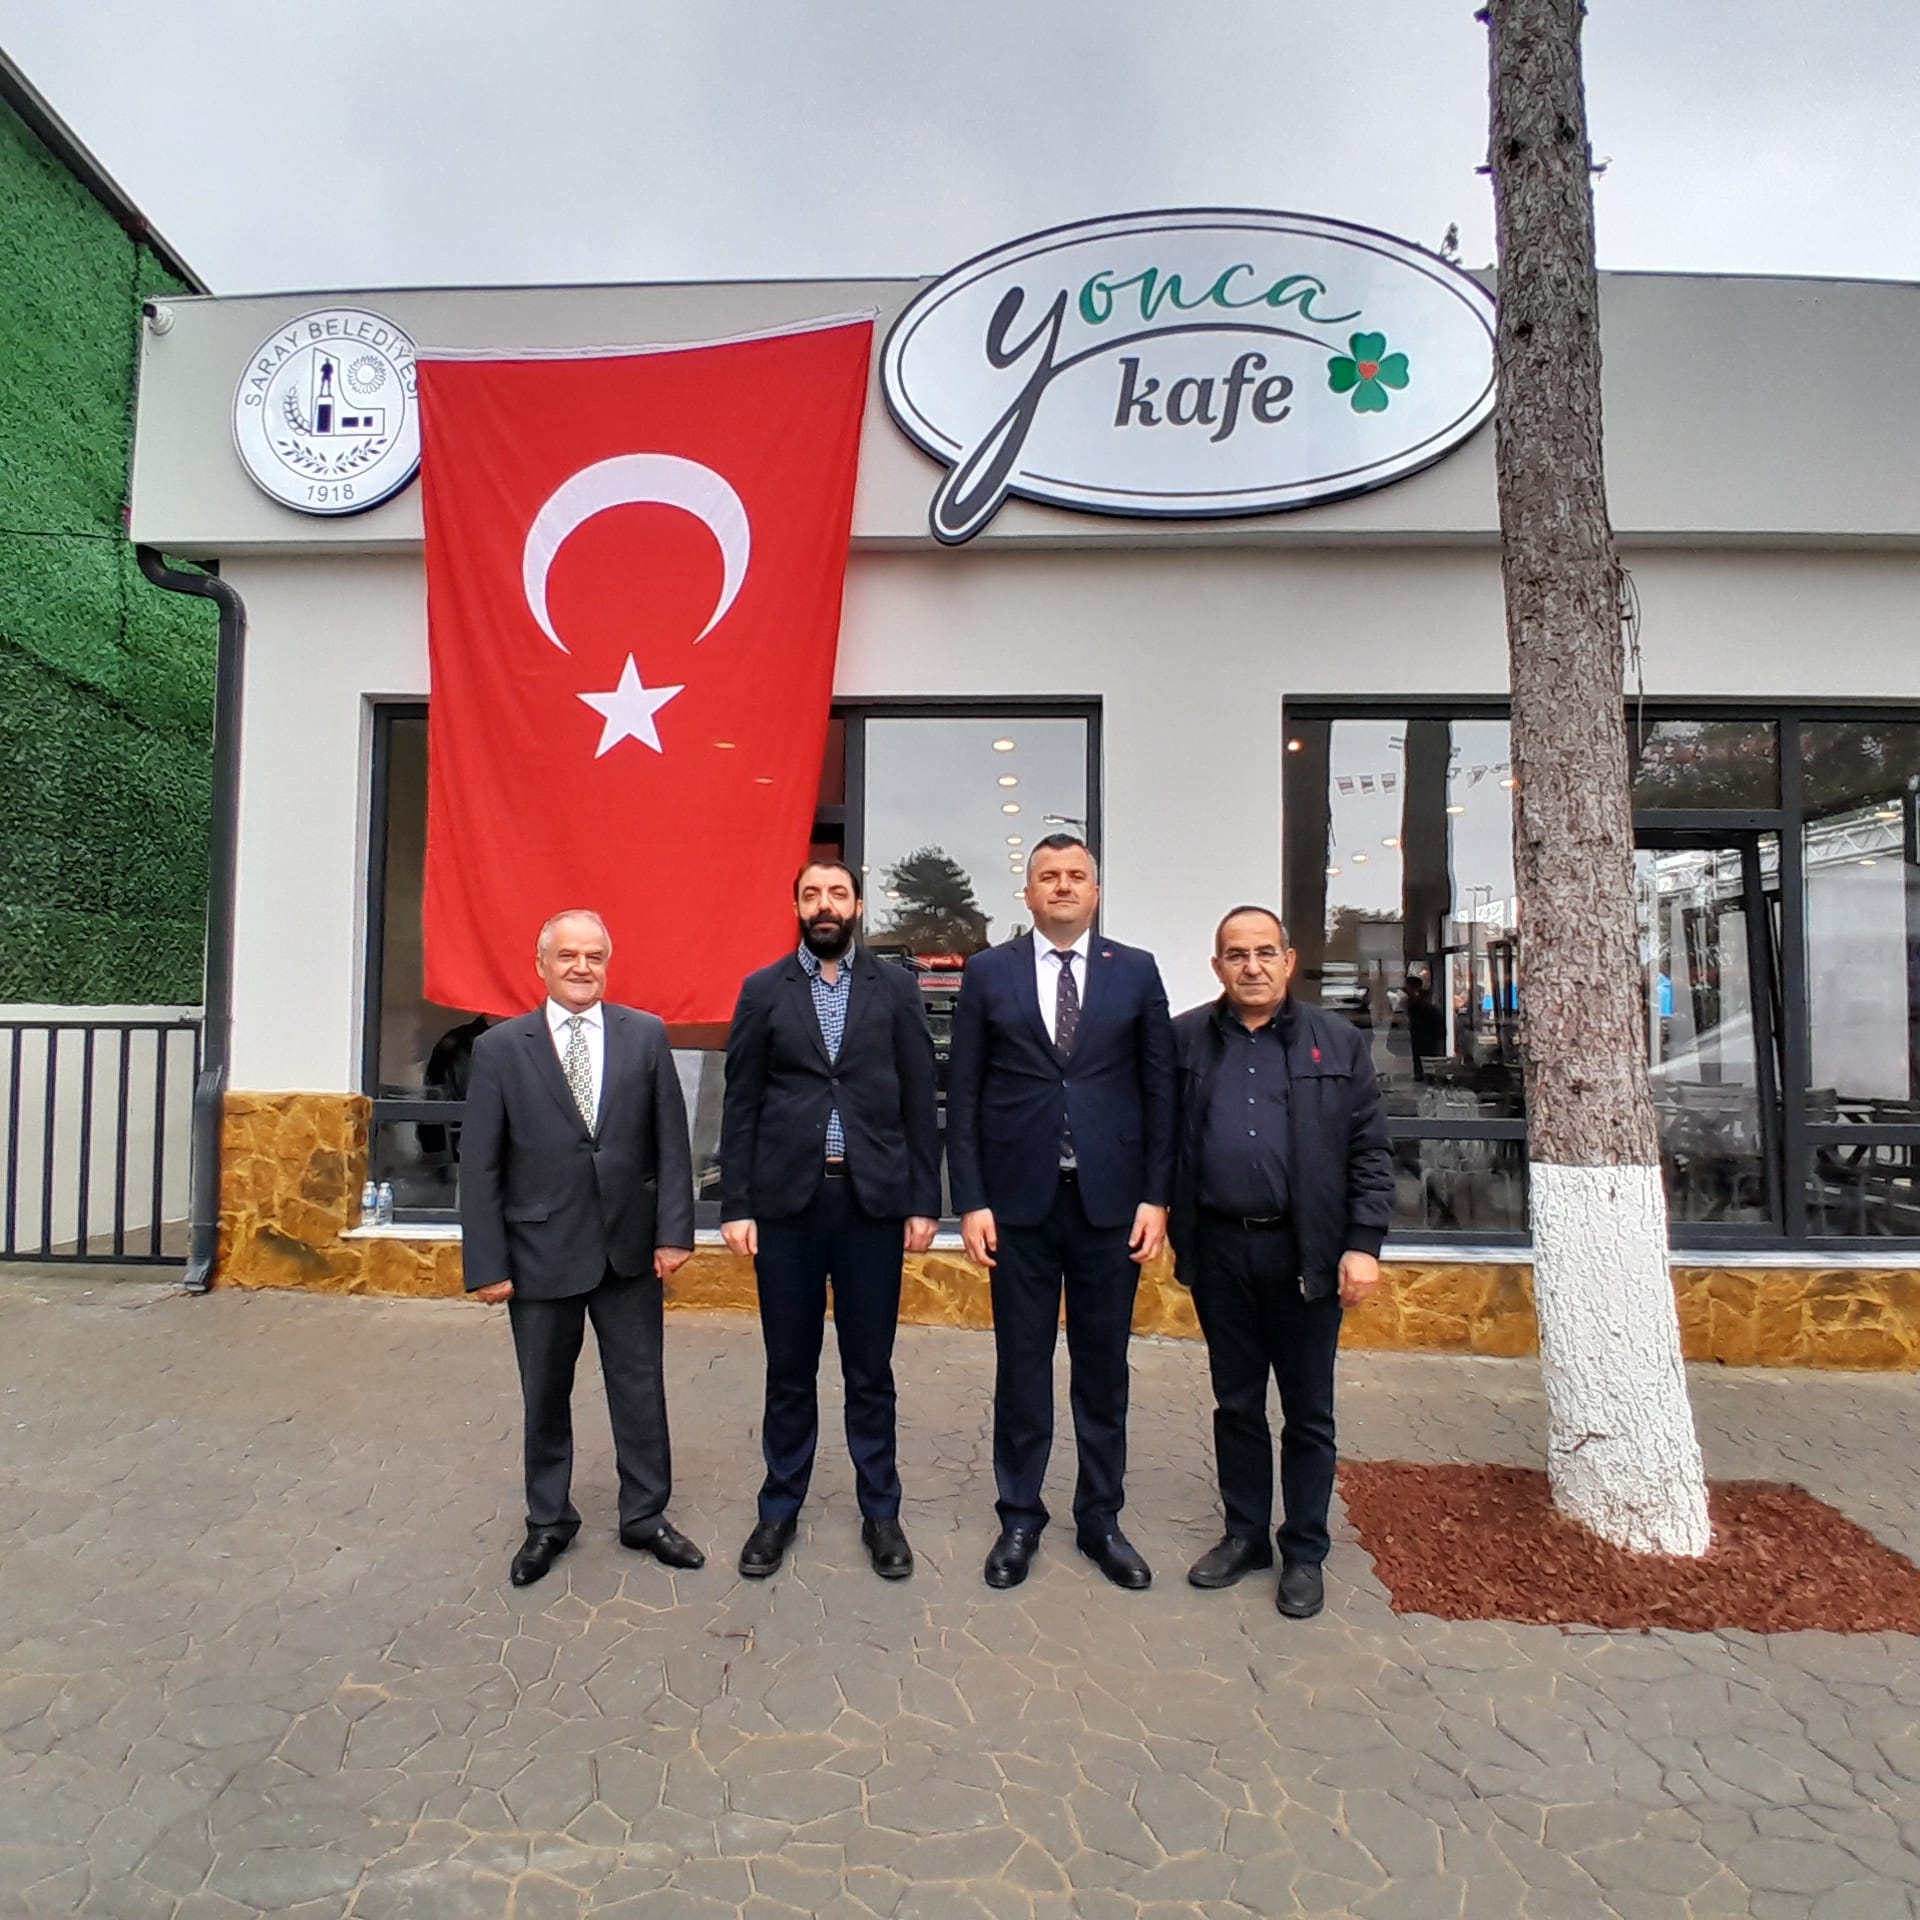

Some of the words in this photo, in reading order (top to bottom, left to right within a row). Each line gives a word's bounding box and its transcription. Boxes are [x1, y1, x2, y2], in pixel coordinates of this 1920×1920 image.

[245, 331, 299, 407] SARAY
[939, 263, 1362, 530] yonca
[1114, 352, 1294, 443] kafe
[307, 484, 355, 502] 1918
